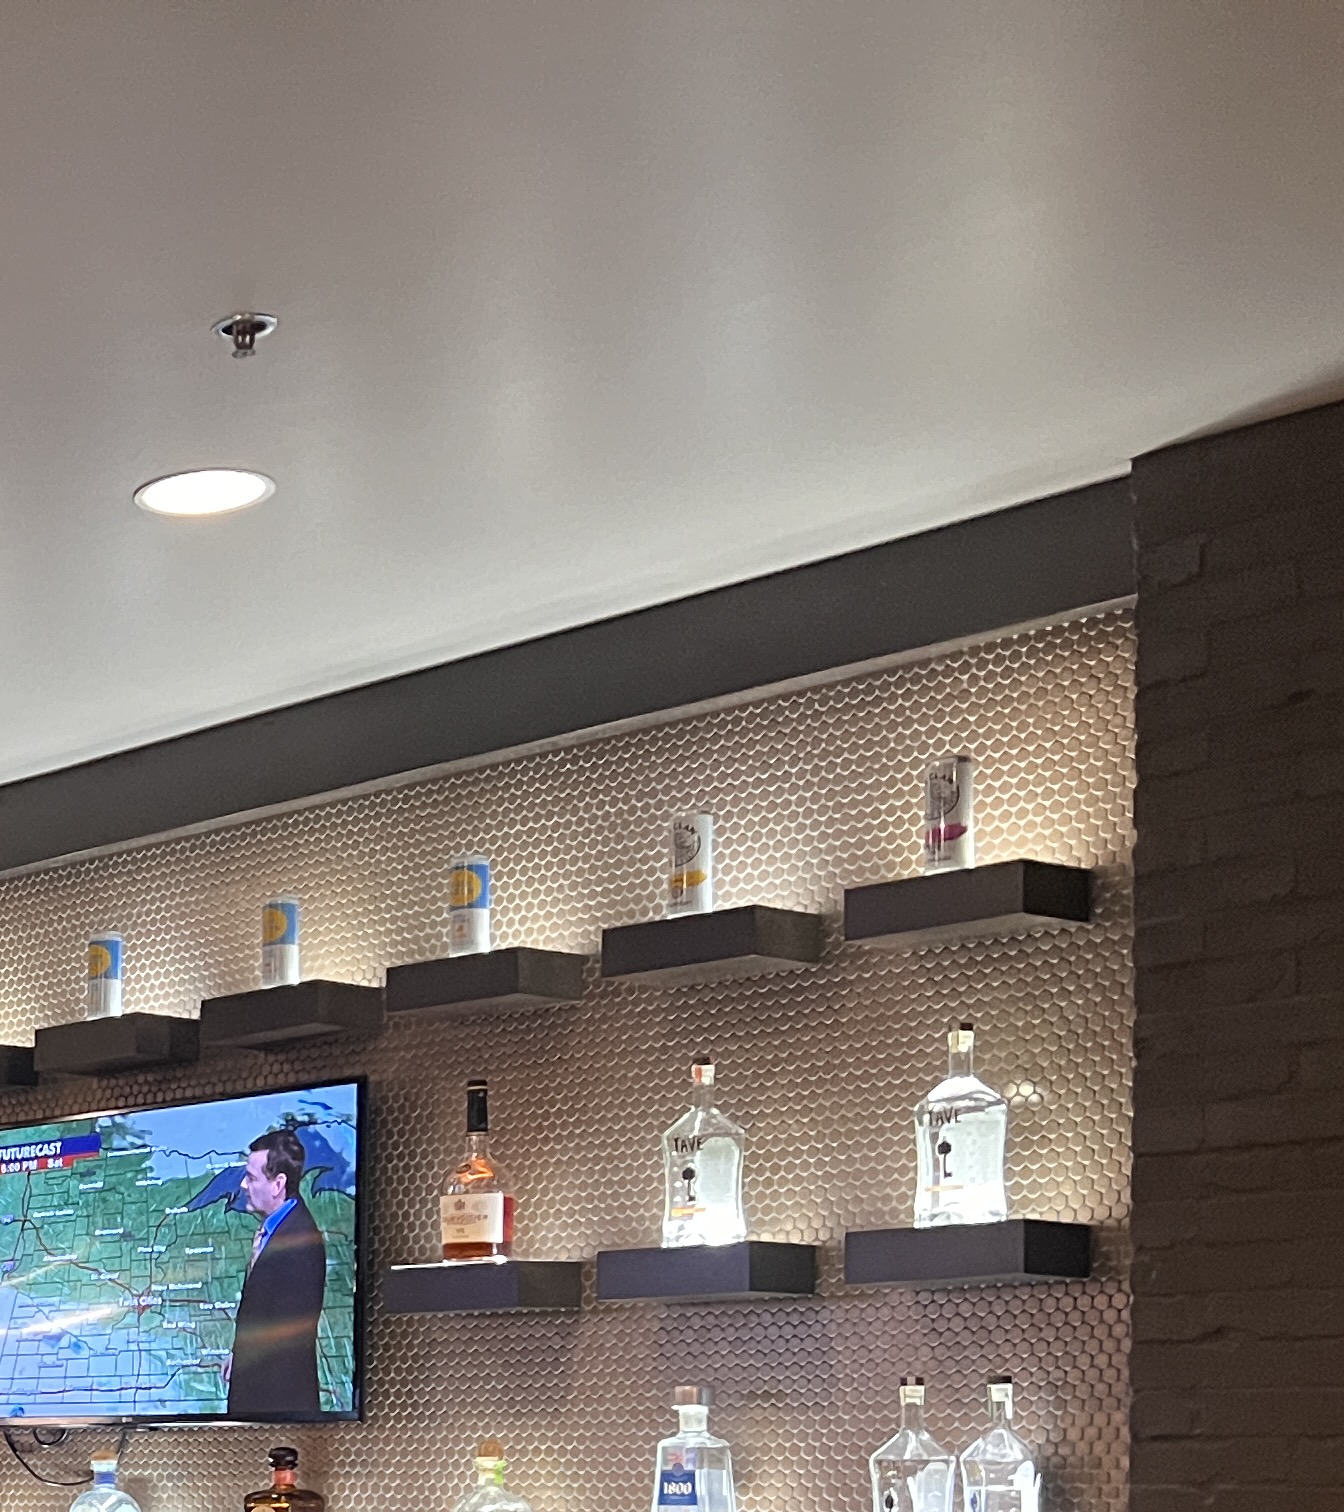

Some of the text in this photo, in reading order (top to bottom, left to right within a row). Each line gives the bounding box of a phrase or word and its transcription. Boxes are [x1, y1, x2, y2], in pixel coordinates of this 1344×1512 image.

[22, 1159, 38, 1172] PM
[47, 1157, 64, 1169] Sat
[663, 1482, 692, 1495] 1800
